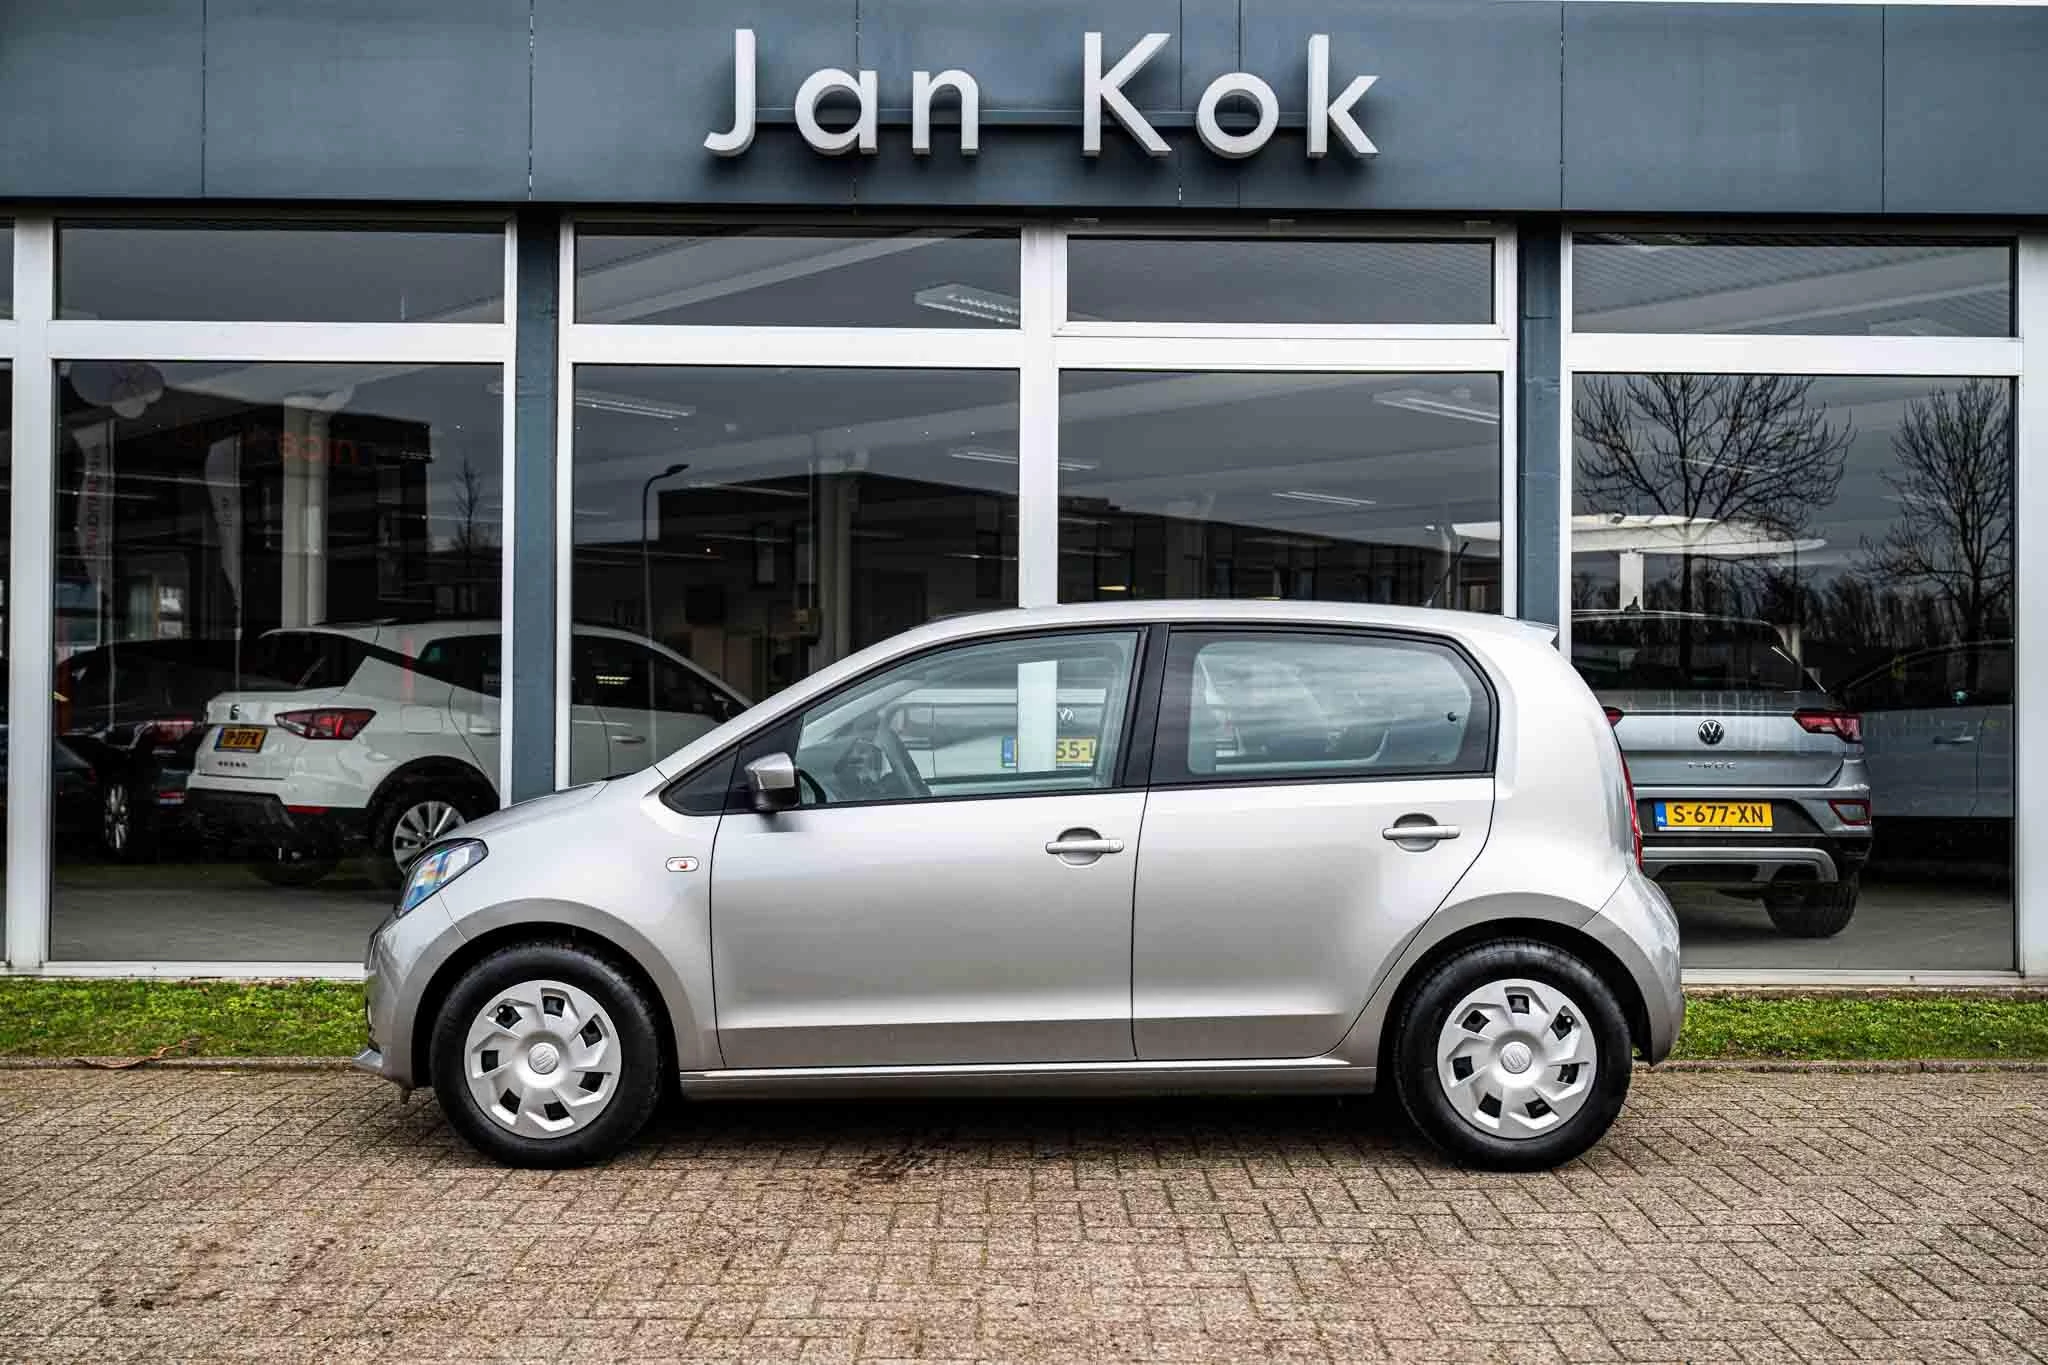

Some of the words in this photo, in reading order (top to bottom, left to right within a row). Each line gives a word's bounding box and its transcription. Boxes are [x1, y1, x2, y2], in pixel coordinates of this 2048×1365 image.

[703, 28, 979, 157] Jan
[1083, 31, 1379, 158] Kok
[1673, 805, 1764, 823] S-677-XN
